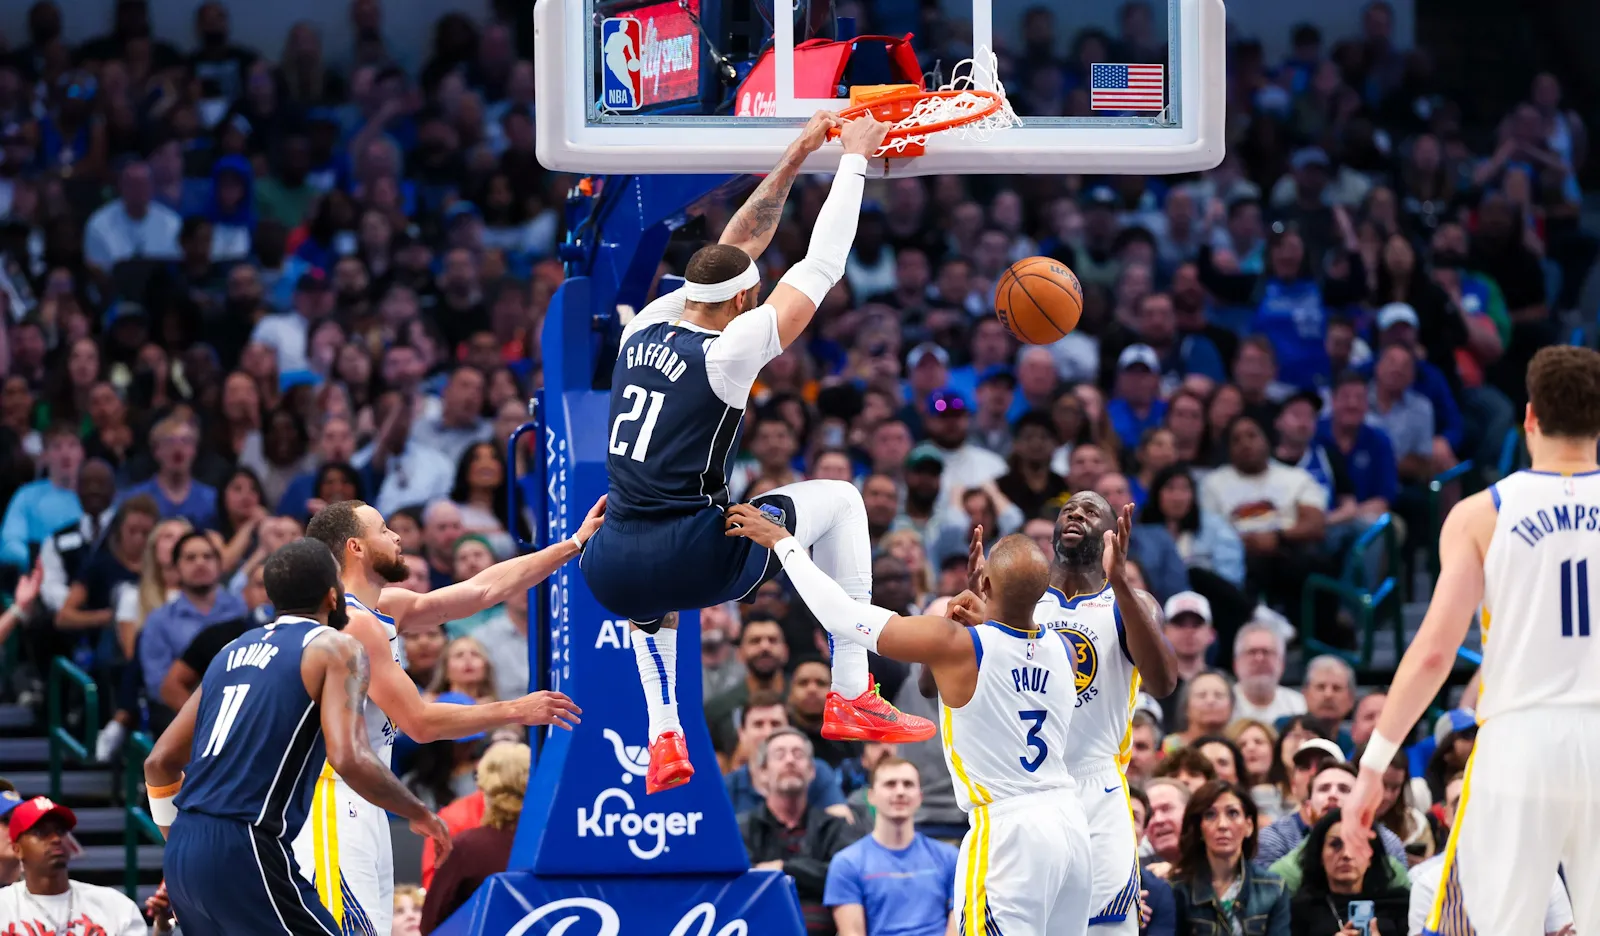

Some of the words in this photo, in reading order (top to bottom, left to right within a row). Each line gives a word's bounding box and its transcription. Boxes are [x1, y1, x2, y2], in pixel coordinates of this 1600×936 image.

[608, 89, 629, 104] NBA
[626, 342, 688, 383] GAFFORD
[609, 384, 666, 463] 21
[1511, 503, 1600, 547] THOMPS
[546, 425, 561, 693] CHOTAW
[1560, 557, 1590, 637] 11
[561, 574, 570, 680] CASINOS
[1047, 620, 1068, 630] DEN
[1073, 622, 1099, 642] STATE
[1075, 642, 1088, 664] 3
[226, 642, 279, 672] IRVING
[1011, 666, 1050, 695] PAUL
[201, 683, 251, 758] 11
[1018, 709, 1049, 773] 3
[577, 787, 704, 860] Kroger
